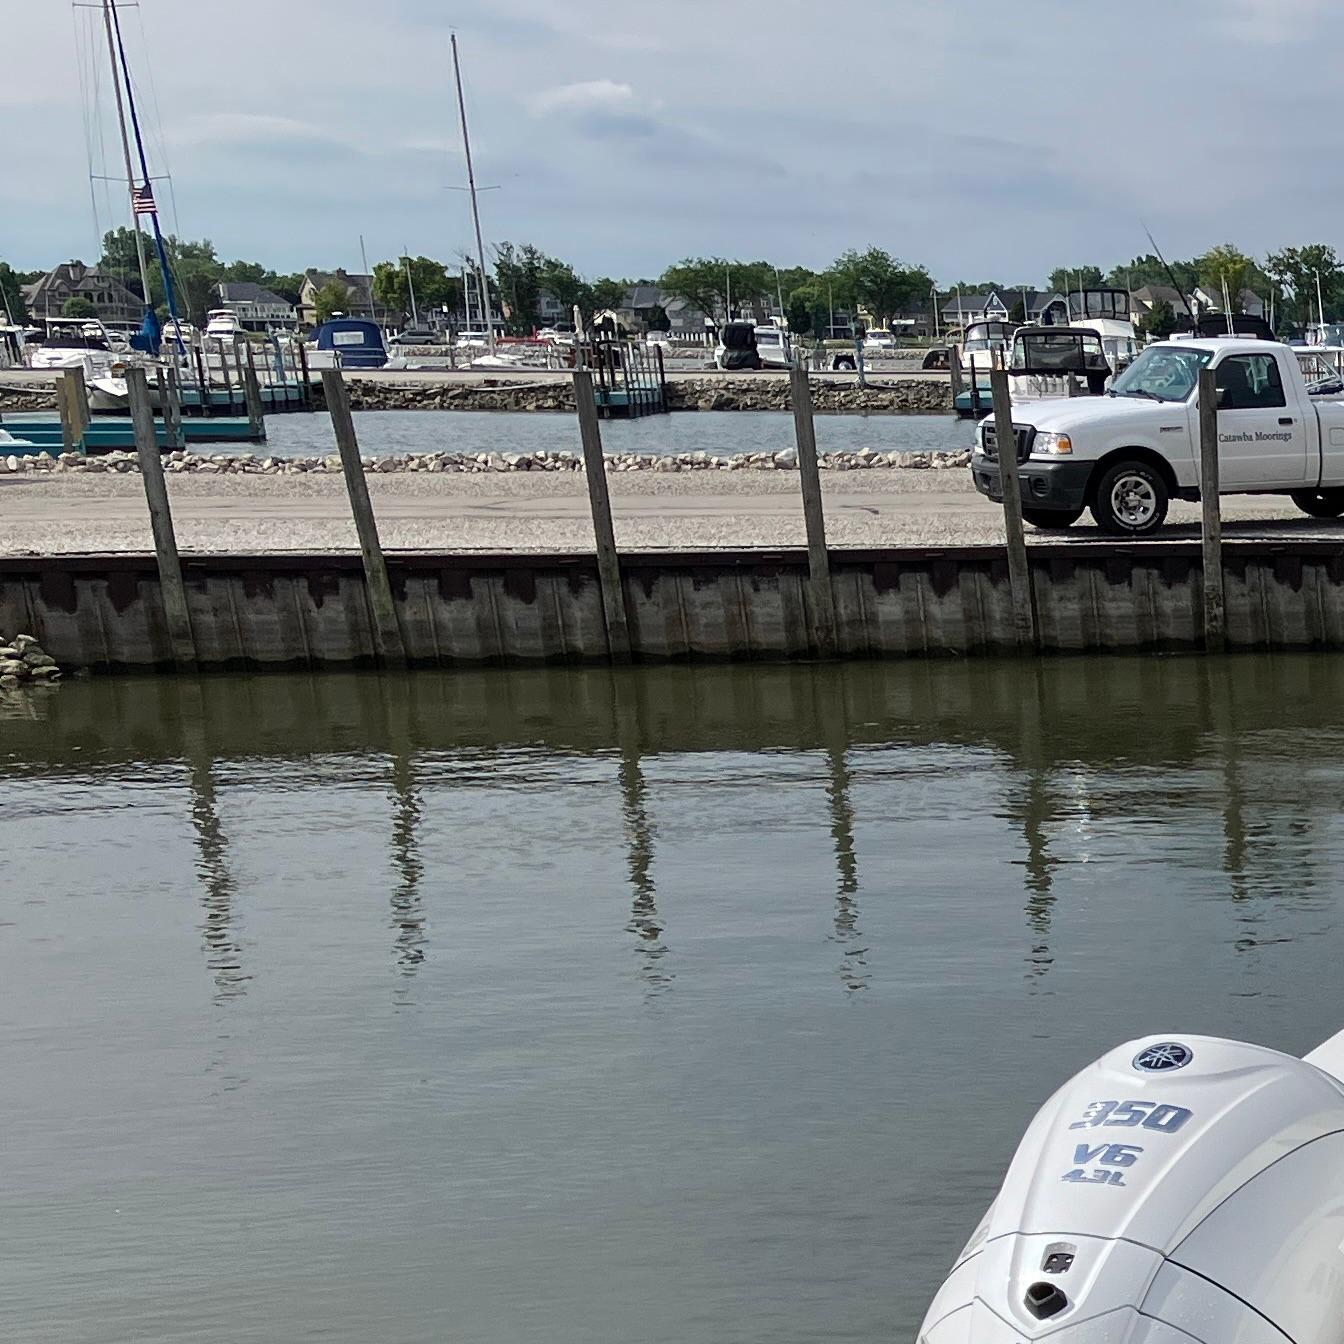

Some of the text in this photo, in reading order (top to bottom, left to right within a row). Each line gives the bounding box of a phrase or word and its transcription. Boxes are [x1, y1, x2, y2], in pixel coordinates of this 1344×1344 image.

[1219, 431, 1292, 443] Catawba Moorings
[1069, 1100, 1193, 1133] 350
[1073, 1143, 1144, 1167] V6
